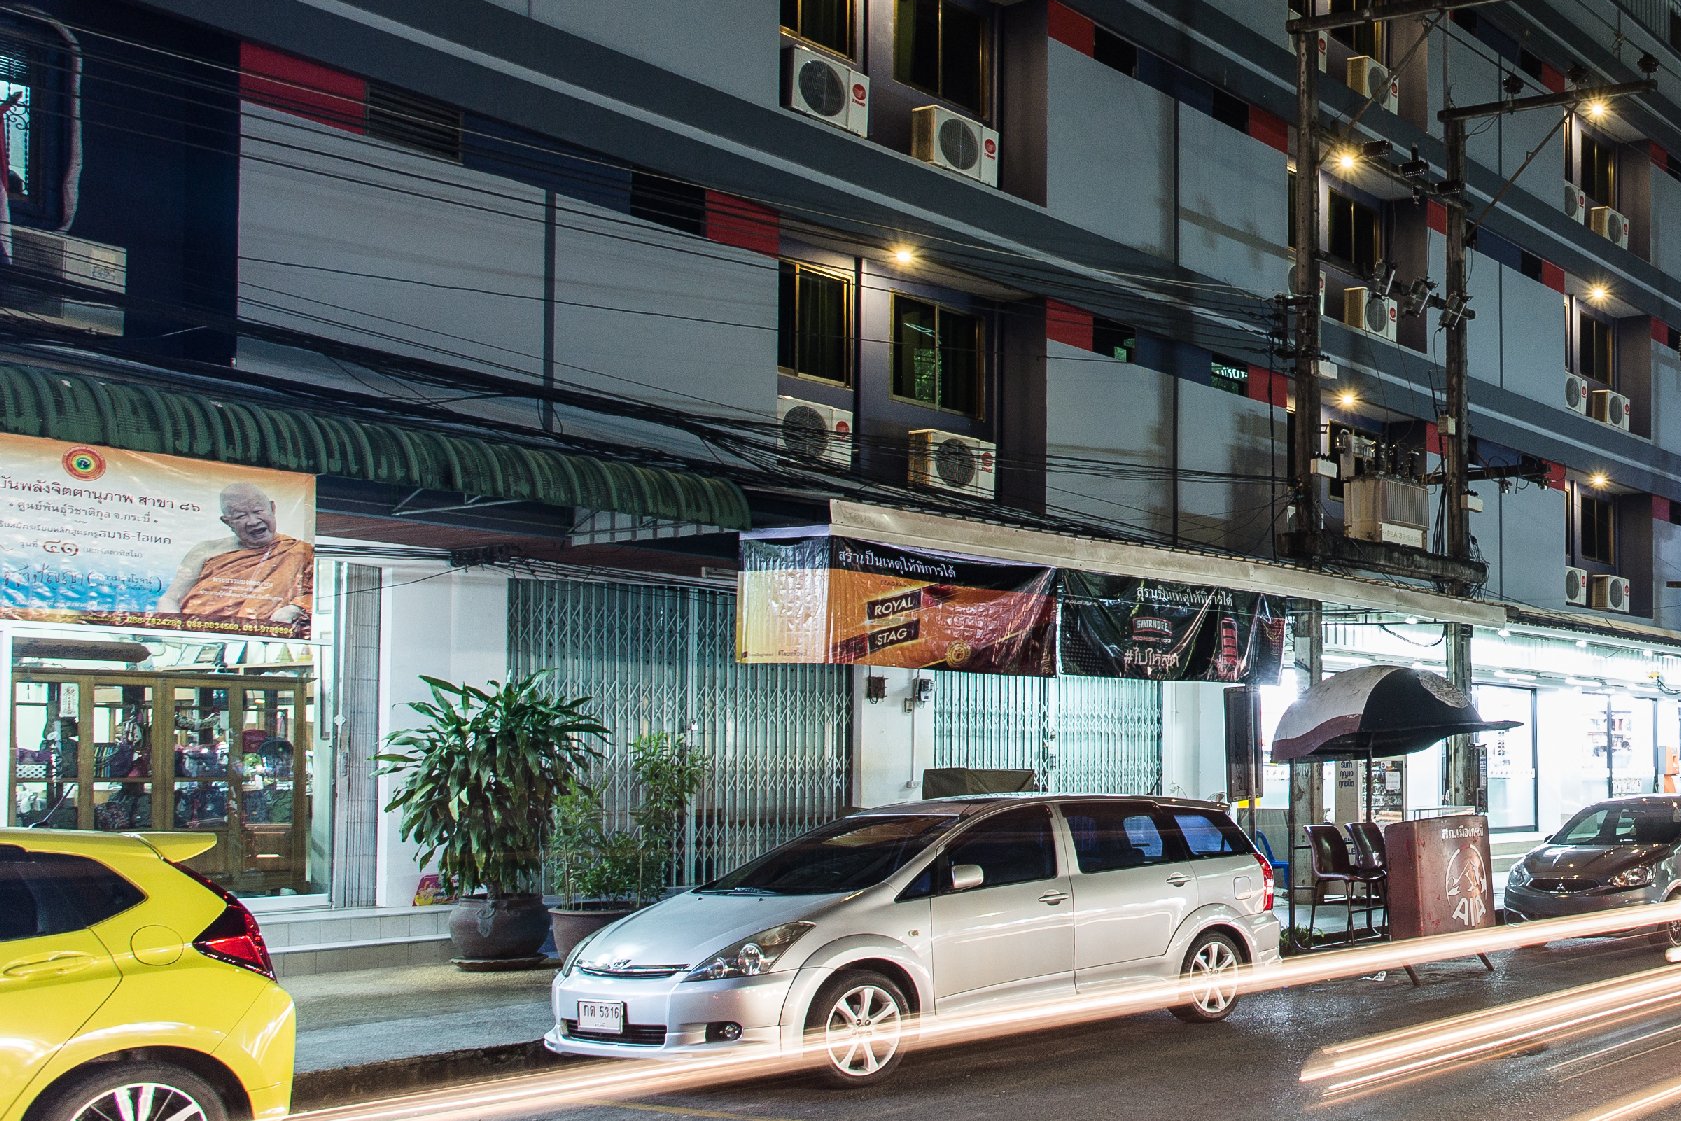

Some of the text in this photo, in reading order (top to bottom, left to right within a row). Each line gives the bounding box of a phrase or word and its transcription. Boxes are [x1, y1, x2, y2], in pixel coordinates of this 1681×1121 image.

[138, 492, 174, 509] สาขา
[838, 549, 957, 578] สุราเป็นเหตุให้พิการได้
[874, 598, 914, 616] ROYAL
[876, 627, 908, 646] STAG
[1452, 896, 1487, 927] AIA
[600, 1005, 620, 1019] 5316
